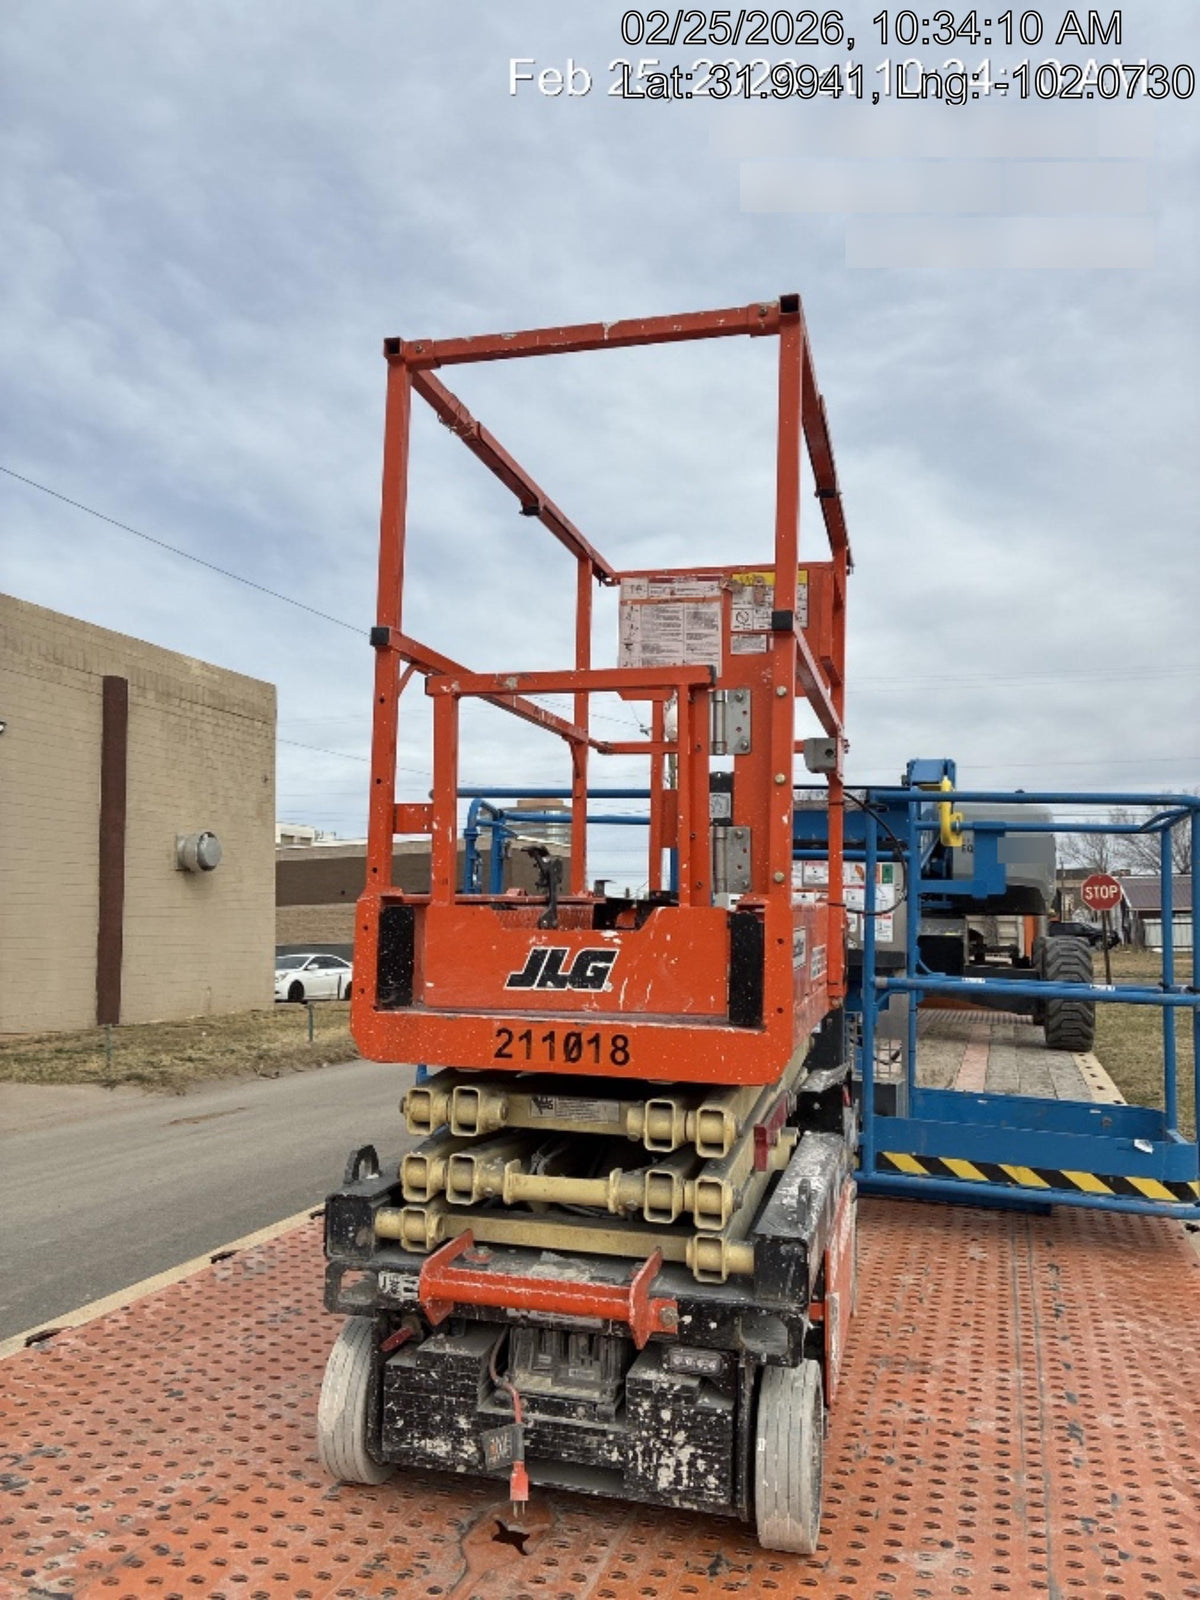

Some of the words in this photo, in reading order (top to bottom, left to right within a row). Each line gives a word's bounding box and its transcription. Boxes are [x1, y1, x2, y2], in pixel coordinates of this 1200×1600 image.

[1085, 885, 1118, 900] STOP
[504, 946, 620, 992] JLG
[494, 1027, 630, 1066] 211018
